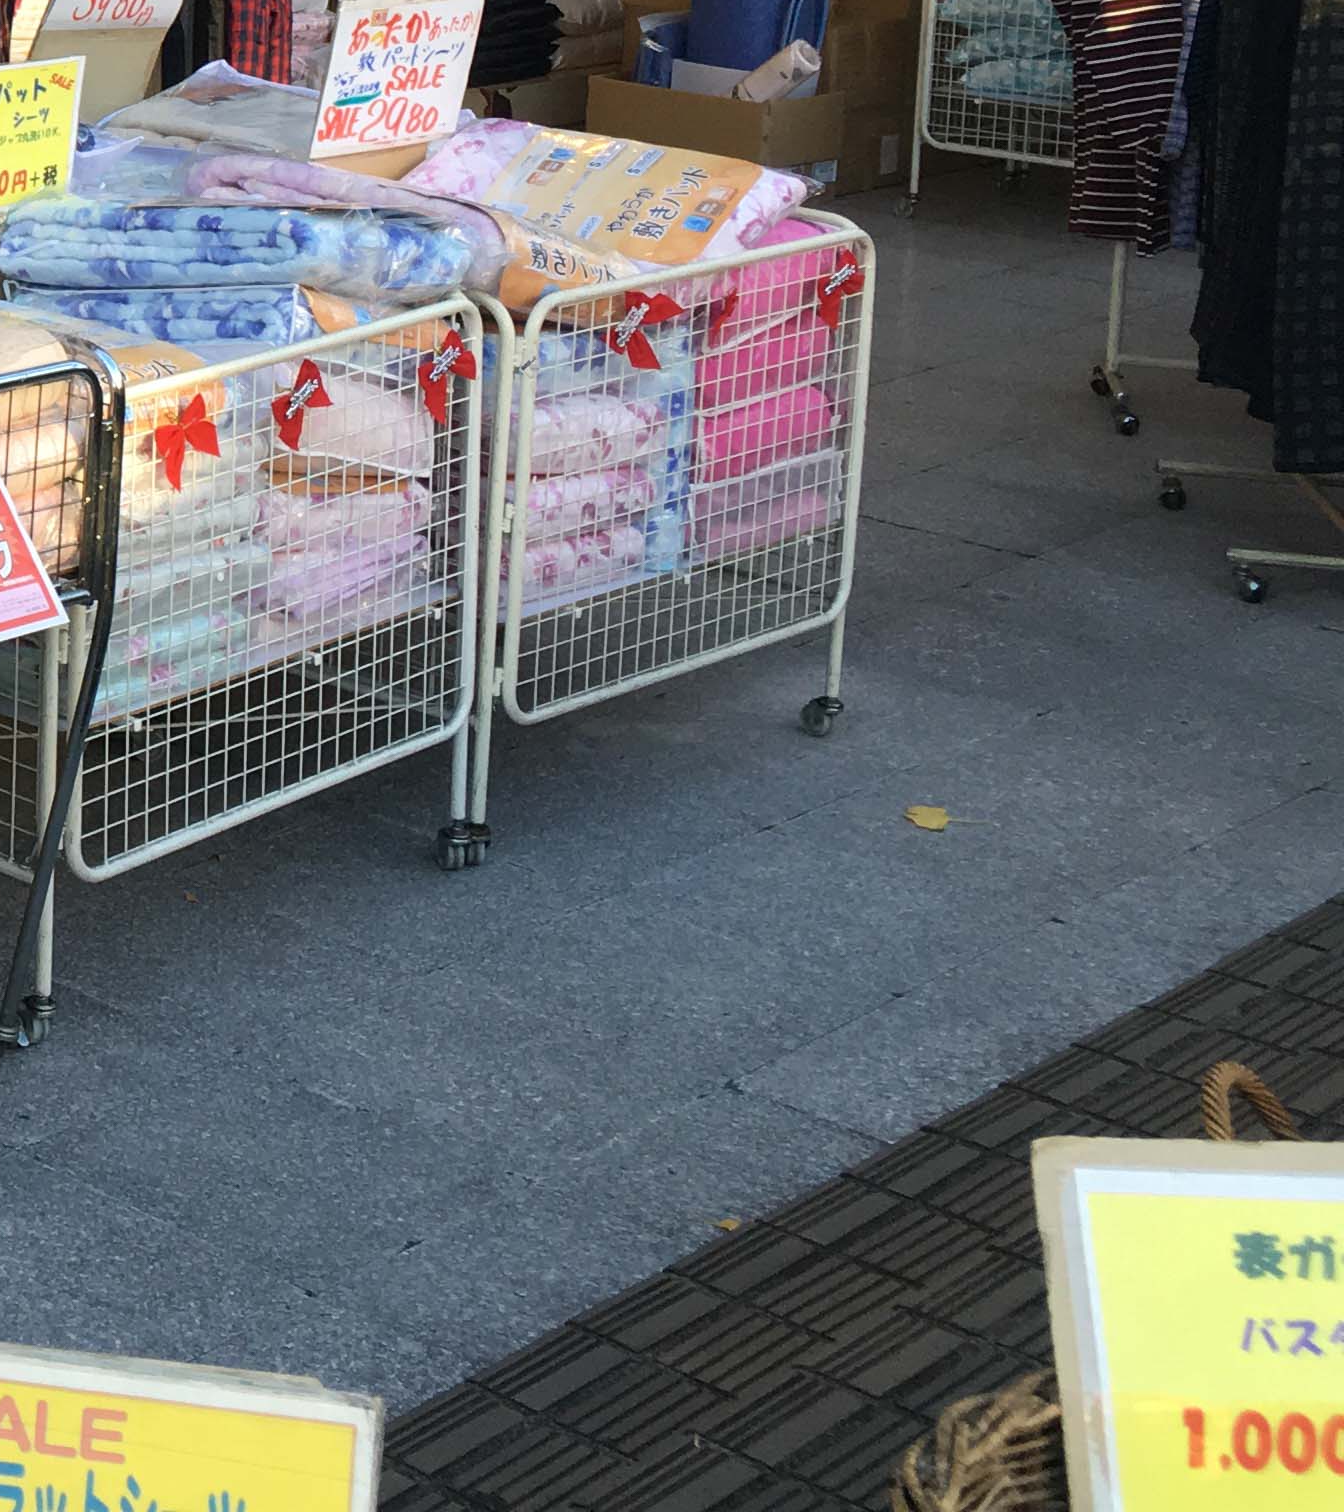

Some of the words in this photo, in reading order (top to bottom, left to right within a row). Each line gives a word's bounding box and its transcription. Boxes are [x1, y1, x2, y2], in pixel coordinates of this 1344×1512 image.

[49, 72, 74, 90] SALE
[384, 63, 446, 96] SALE
[12, 107, 50, 128] シーツ
[318, 105, 362, 142] SALE
[606, 187, 655, 233] やわらか
[1234, 1232, 1344, 1281] 表ガ
